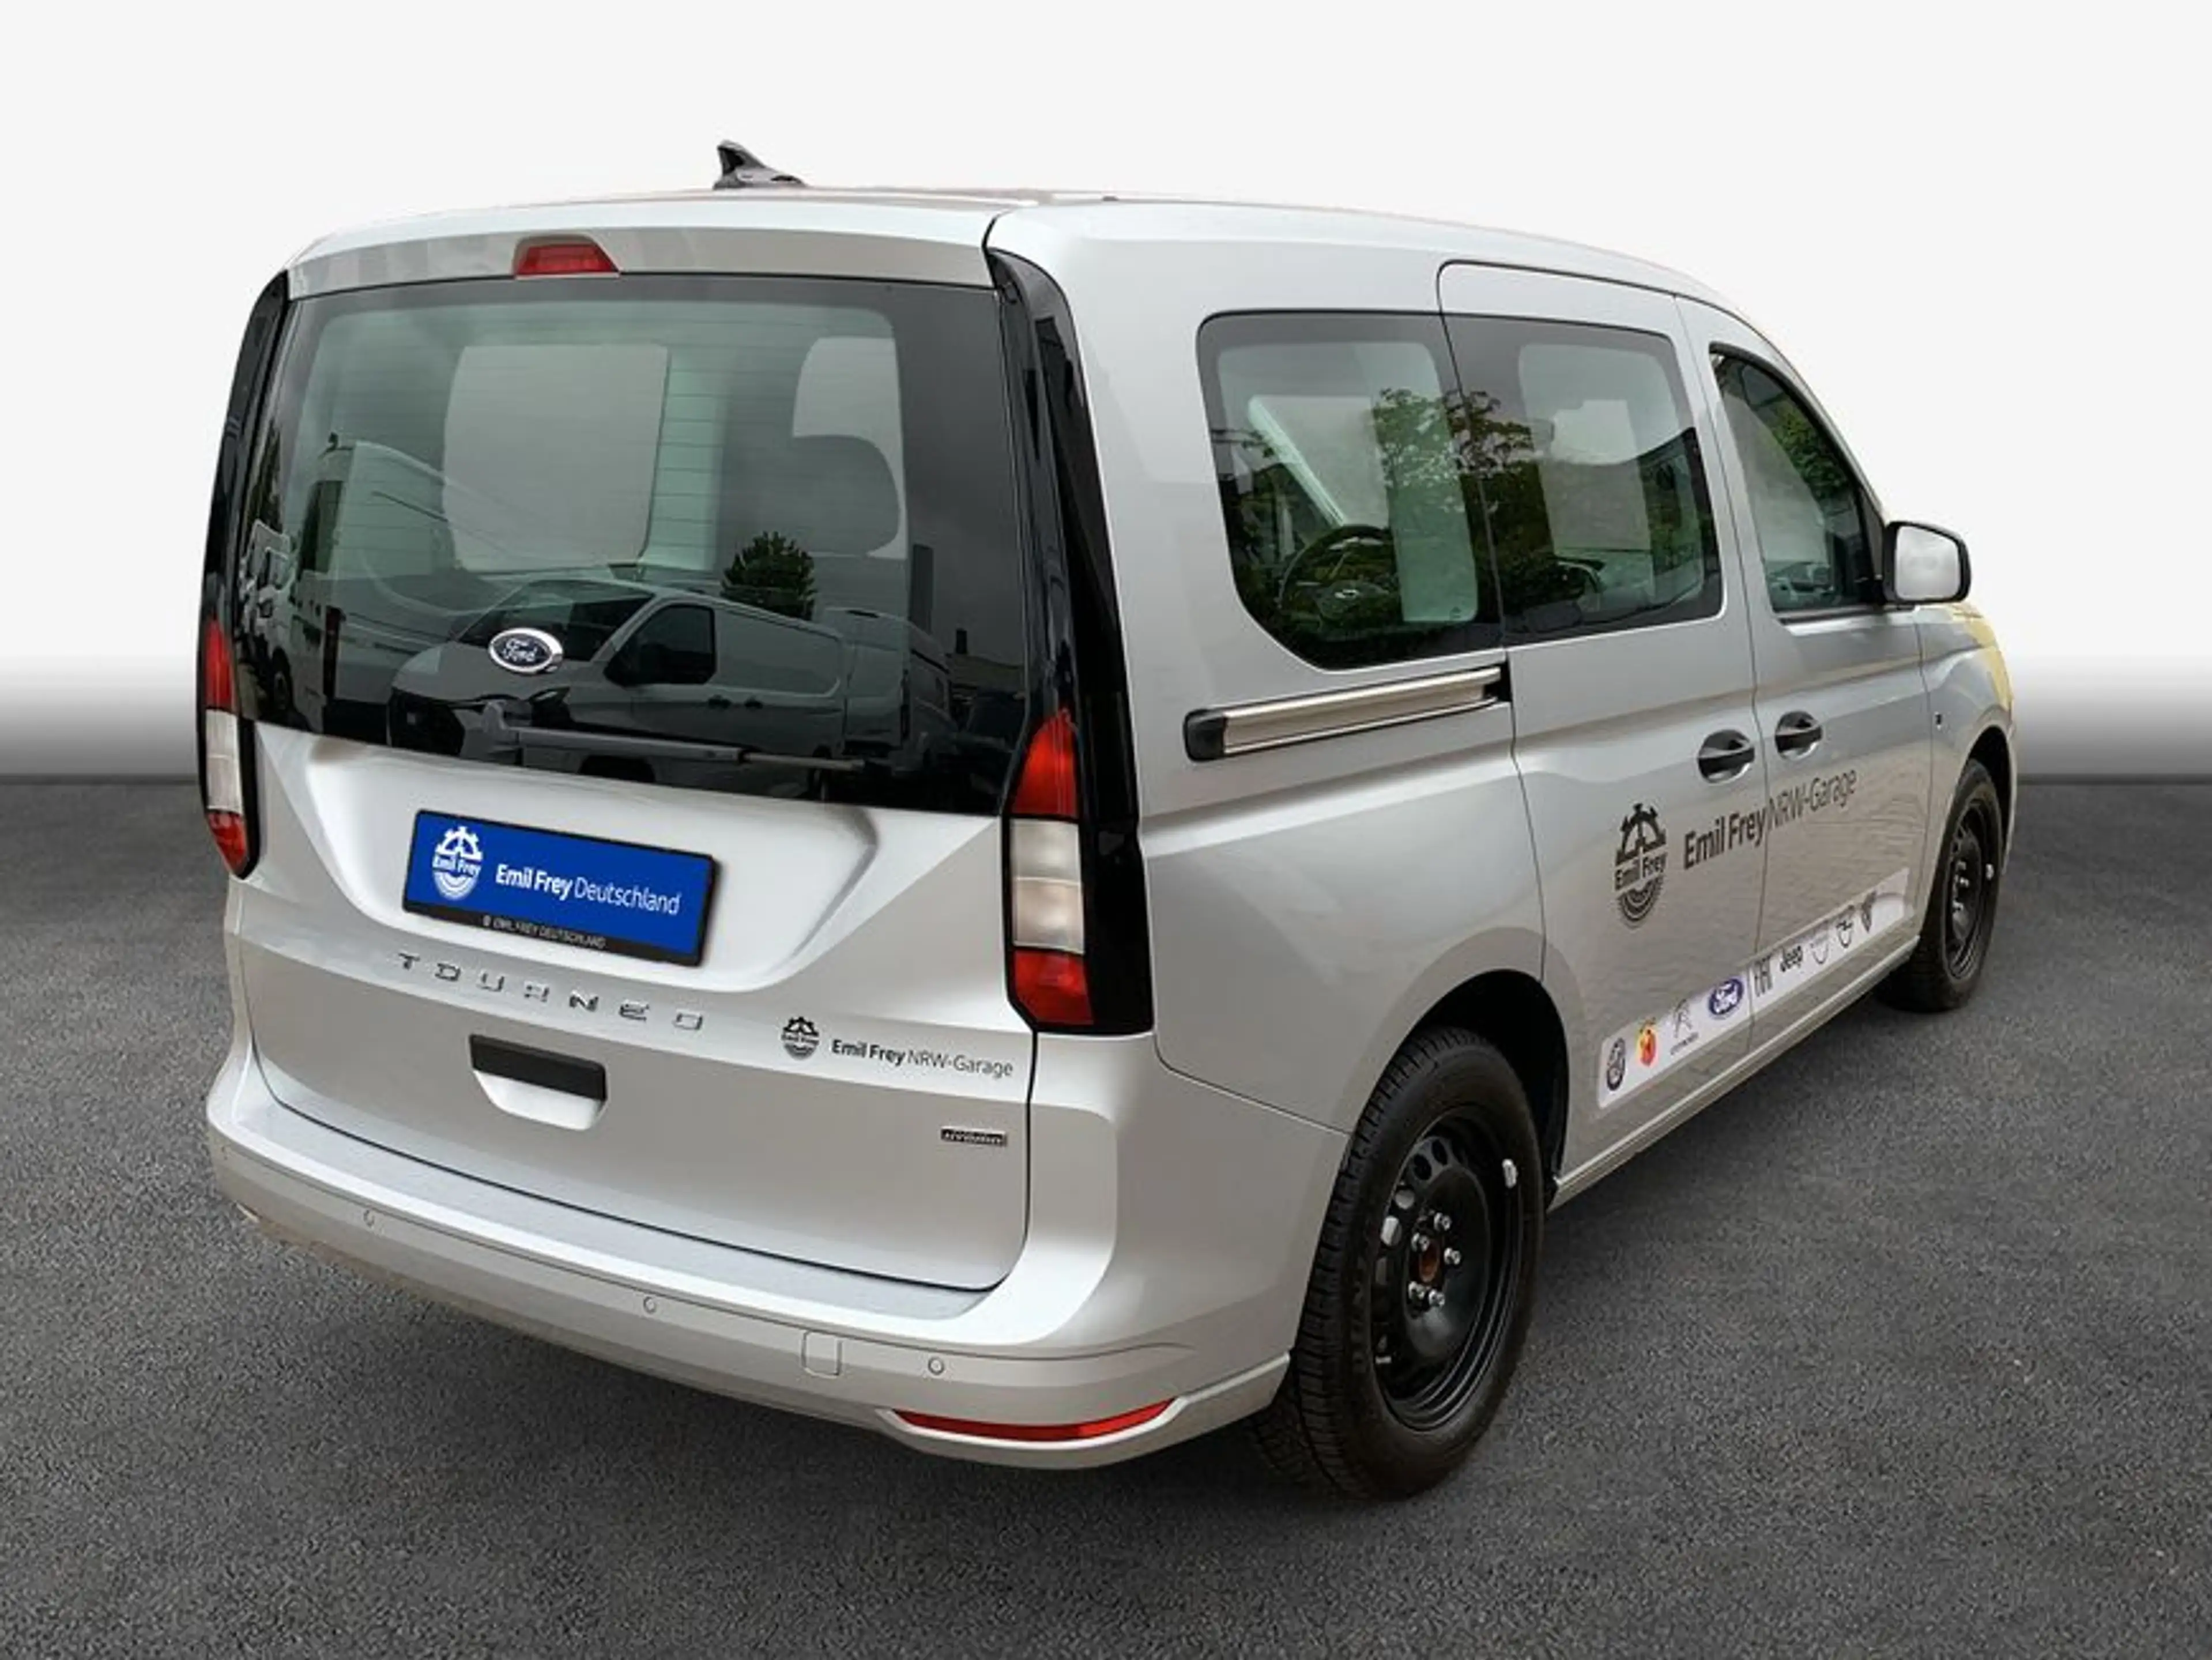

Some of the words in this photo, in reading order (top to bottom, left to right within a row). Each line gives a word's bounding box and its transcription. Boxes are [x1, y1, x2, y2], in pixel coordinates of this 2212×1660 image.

[1683, 816, 1725, 869] Emil
[1729, 807, 1766, 850] Frey
[1767, 769, 1857, 829] NRW-Garage
[496, 864, 533, 889] Emil
[534, 870, 572, 901] Frey
[574, 877, 682, 915] Deutschland
[398, 952, 703, 1031] TOURNEO
[832, 1039, 866, 1059] Emil
[869, 1044, 906, 1067] Frey
[908, 1049, 1013, 1078] NRW-Garage
